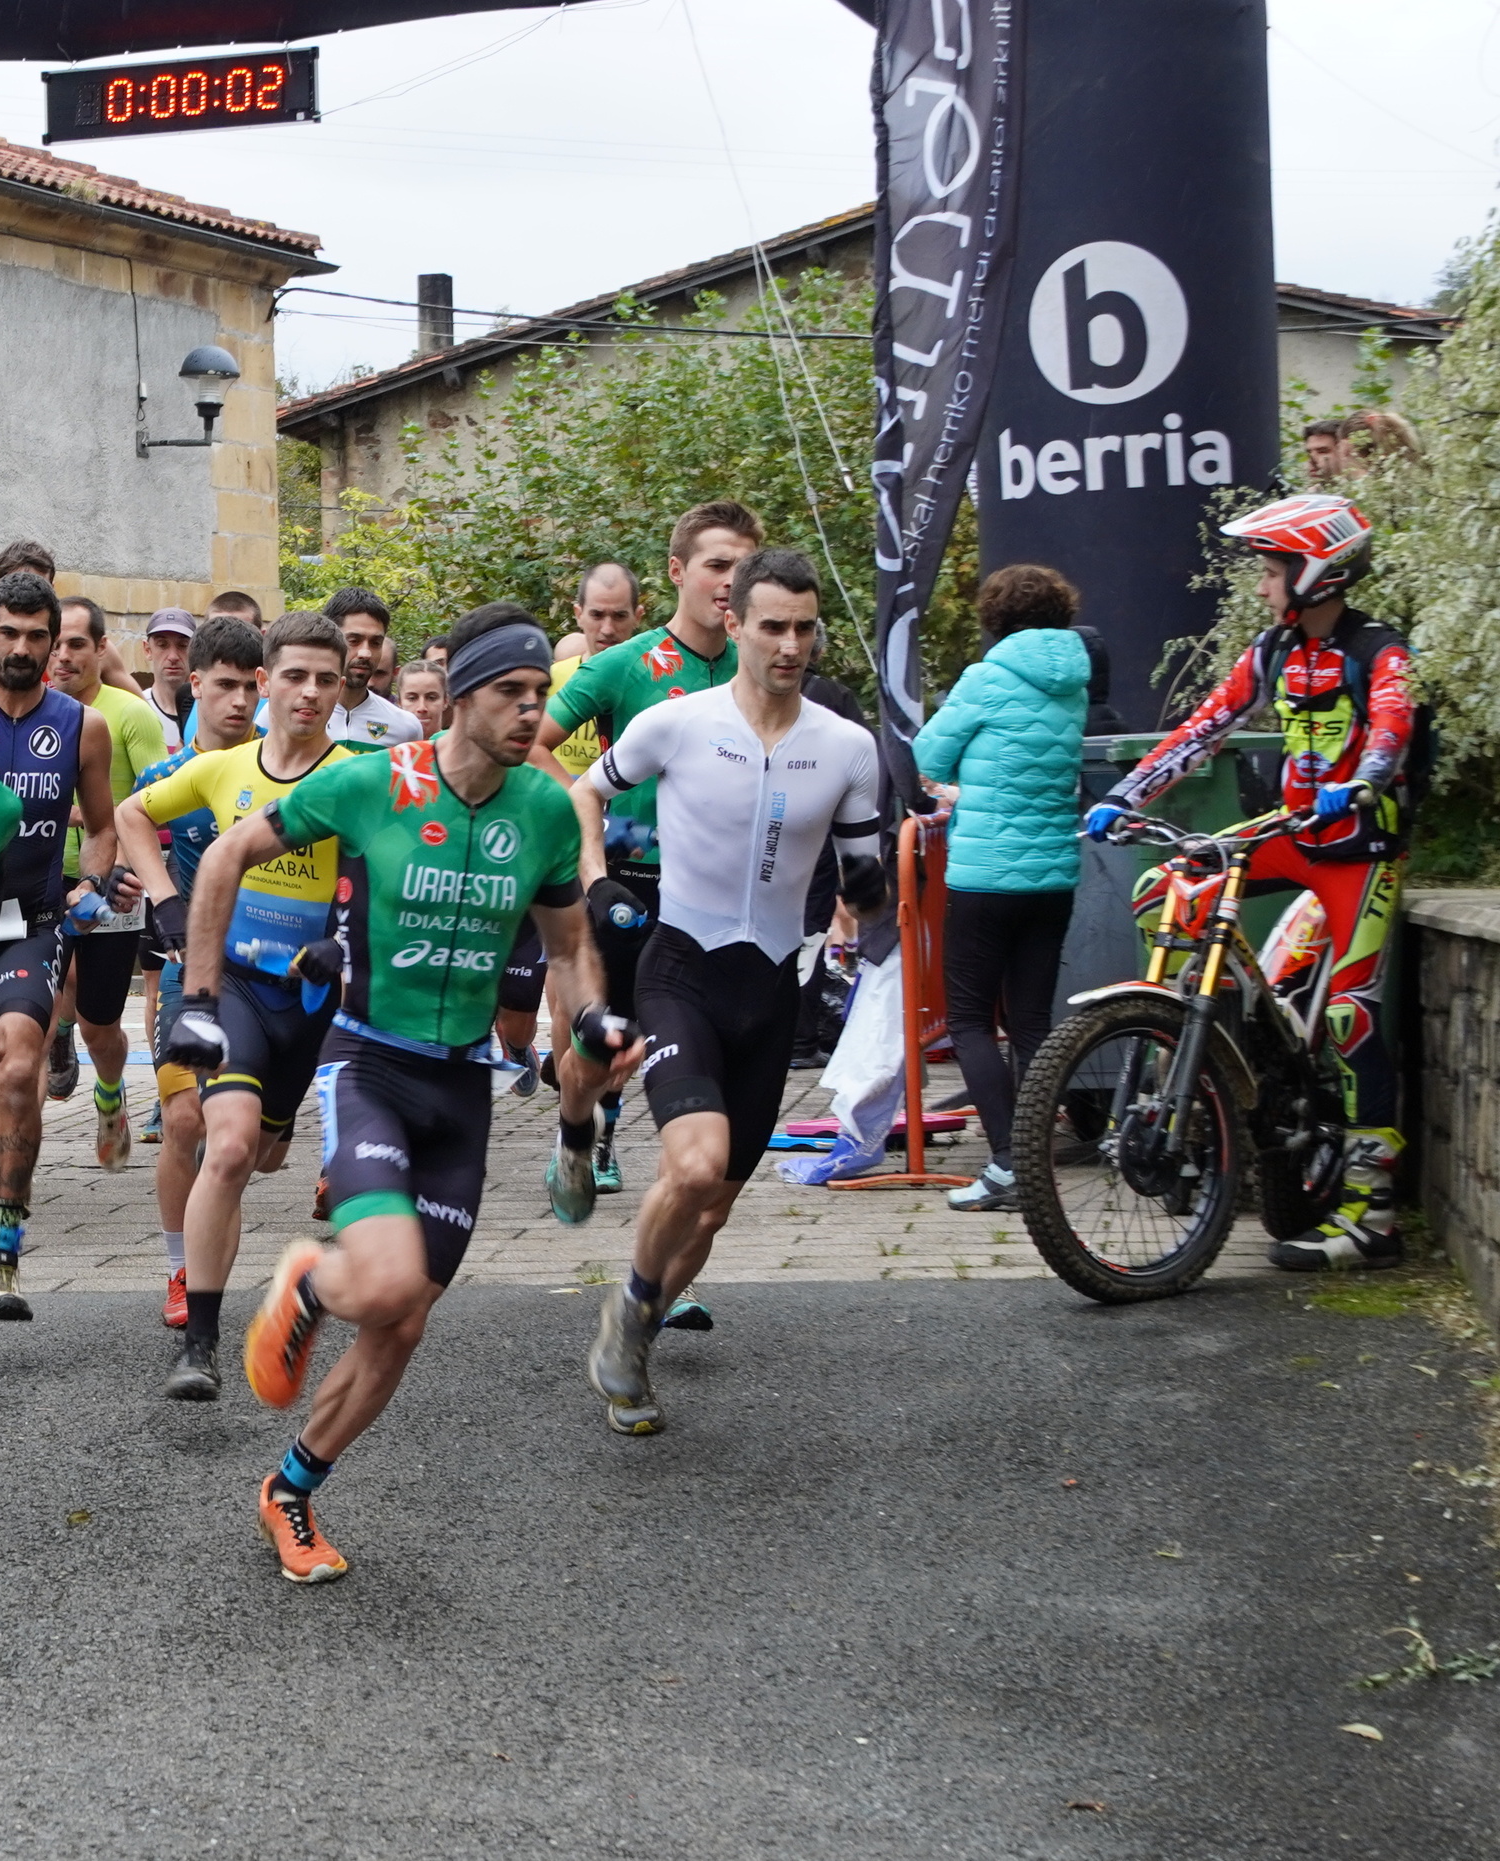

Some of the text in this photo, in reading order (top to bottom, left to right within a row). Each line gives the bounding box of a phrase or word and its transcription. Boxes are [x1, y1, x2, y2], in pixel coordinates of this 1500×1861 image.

[107, 66, 284, 123] 0:00:02
[999, 413, 1232, 500] berria
[716, 747, 747, 763] Stern
[787, 760, 817, 769] GOBIK
[759, 791, 786, 883] STERN FACTORY TEAM
[402, 863, 517, 911] URRESTA
[246, 905, 302, 924] aranburu
[398, 911, 500, 934] IDIAZABAL
[429, 947, 497, 971] asics
